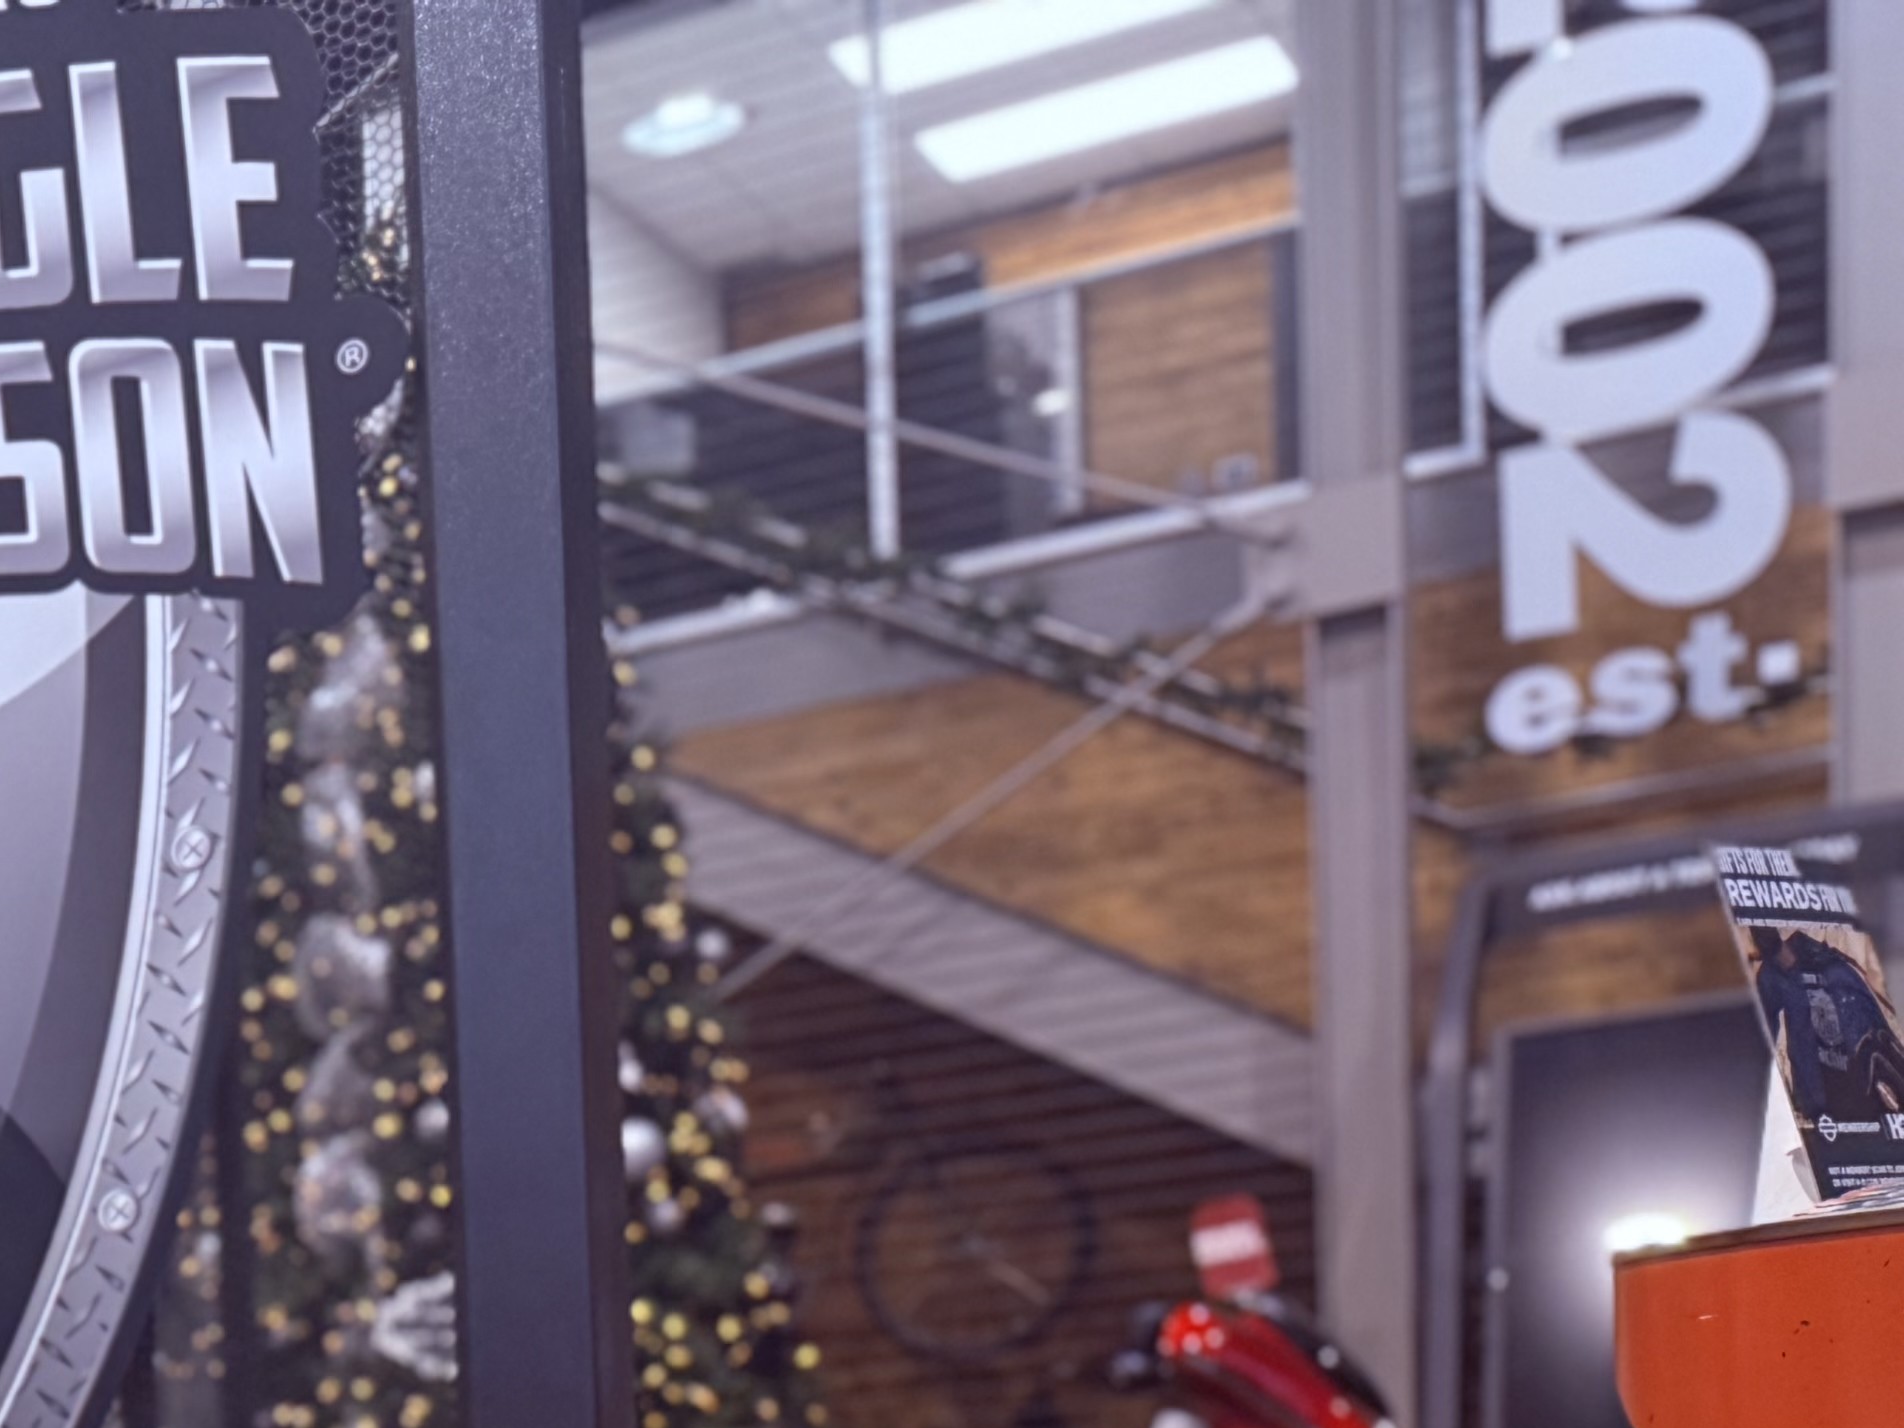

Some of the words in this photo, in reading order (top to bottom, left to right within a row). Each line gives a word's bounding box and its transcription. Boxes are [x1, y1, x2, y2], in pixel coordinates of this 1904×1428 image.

[1478, 0, 1790, 643] 002
[1483, 610, 1801, 756] est.
[1724, 877, 1826, 913] REWARDS
